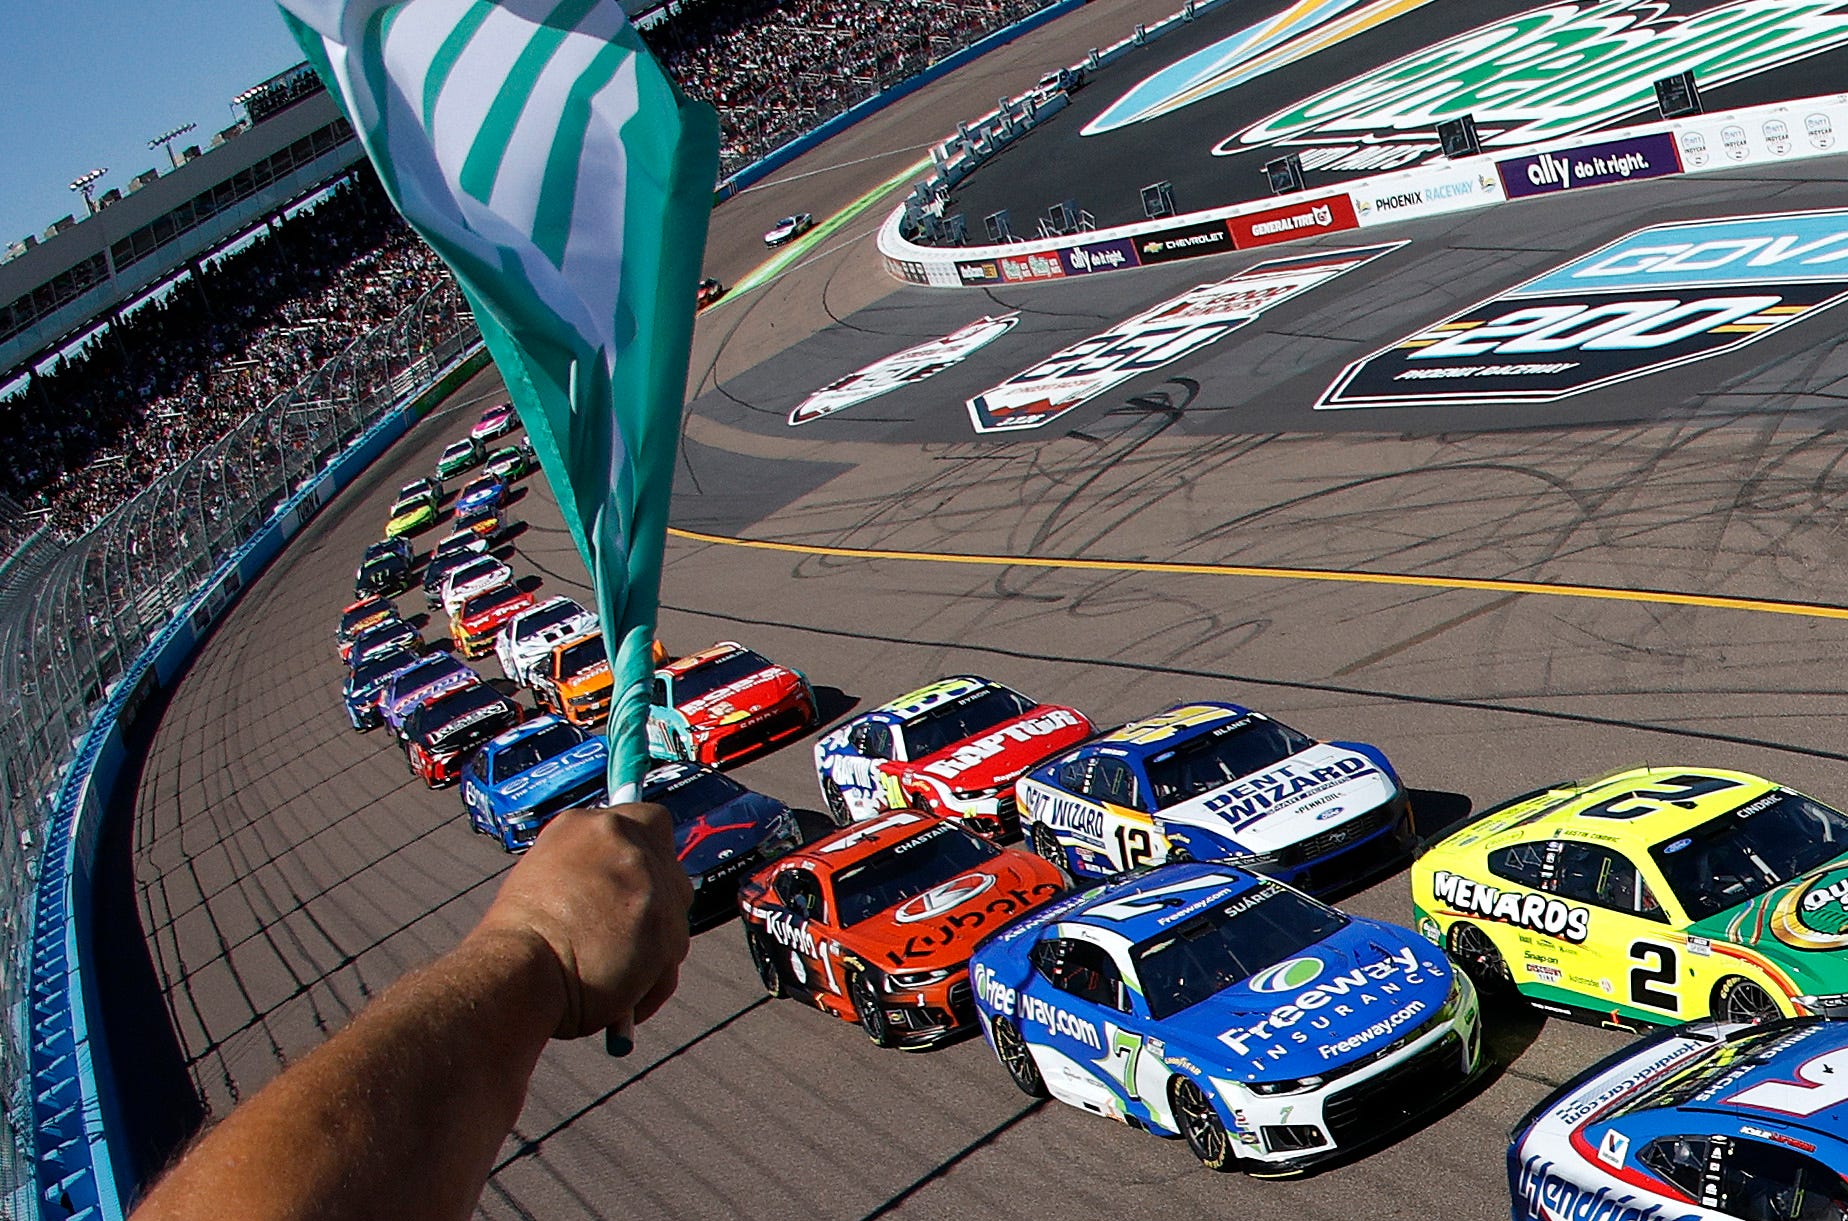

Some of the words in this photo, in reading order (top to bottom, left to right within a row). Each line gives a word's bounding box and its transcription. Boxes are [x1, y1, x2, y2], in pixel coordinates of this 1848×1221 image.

[1527, 154, 1569, 188] ally
[1575, 162, 1594, 179] do
[1594, 158, 1606, 176] it
[1606, 152, 1650, 178] right.
[1375, 191, 1423, 213] PHOENIX
[1425, 180, 1474, 202] RACEWAY
[1165, 231, 1224, 250] CHEVROLET
[1251, 218, 1295, 238] GENERAL
[1292, 212, 1316, 230] TIRE
[1070, 247, 1092, 272] ally
[1406, 295, 1784, 360] 200
[739, 708, 781, 729] CAMRY
[957, 688, 992, 708] BYRON
[922, 707, 1081, 780] RAPTOR
[1212, 718, 1253, 737] BLANEY
[500, 742, 605, 797] eero
[667, 772, 706, 792] REDDICK
[1202, 764, 1296, 812] DENT
[1216, 757, 1367, 825] WIZARD
[1025, 785, 1051, 823] DENT
[1050, 797, 1105, 839] WIZARD
[1299, 792, 1341, 815] PENNZOIL
[1579, 774, 1750, 820] 2
[1736, 793, 1783, 819] CINDRIC
[893, 824, 952, 854] CHASTAIN
[1114, 822, 1153, 872] 12
[707, 854, 756, 883] CAMRY
[1080, 874, 1238, 922] 7
[1156, 887, 1232, 927] Freeway.com
[1223, 885, 1279, 919] SUÁREZ
[1434, 870, 1588, 944] MENARDS
[817, 940, 842, 996] 1
[1629, 940, 1680, 1013] 2
[984, 967, 1102, 1050] Freeway.com
[1216, 944, 1420, 1058] Freeway
[1251, 965, 1445, 1073] INSURANCE
[1316, 998, 1427, 1061] Freeway.com
[1759, 1024, 1826, 1060] HIRING
[1112, 1027, 1143, 1102] 7
[1563, 1040, 1705, 1126] HendrickCars.com
[1696, 1064, 1757, 1103] TECHS
[1279, 1105, 1295, 1125] 7
